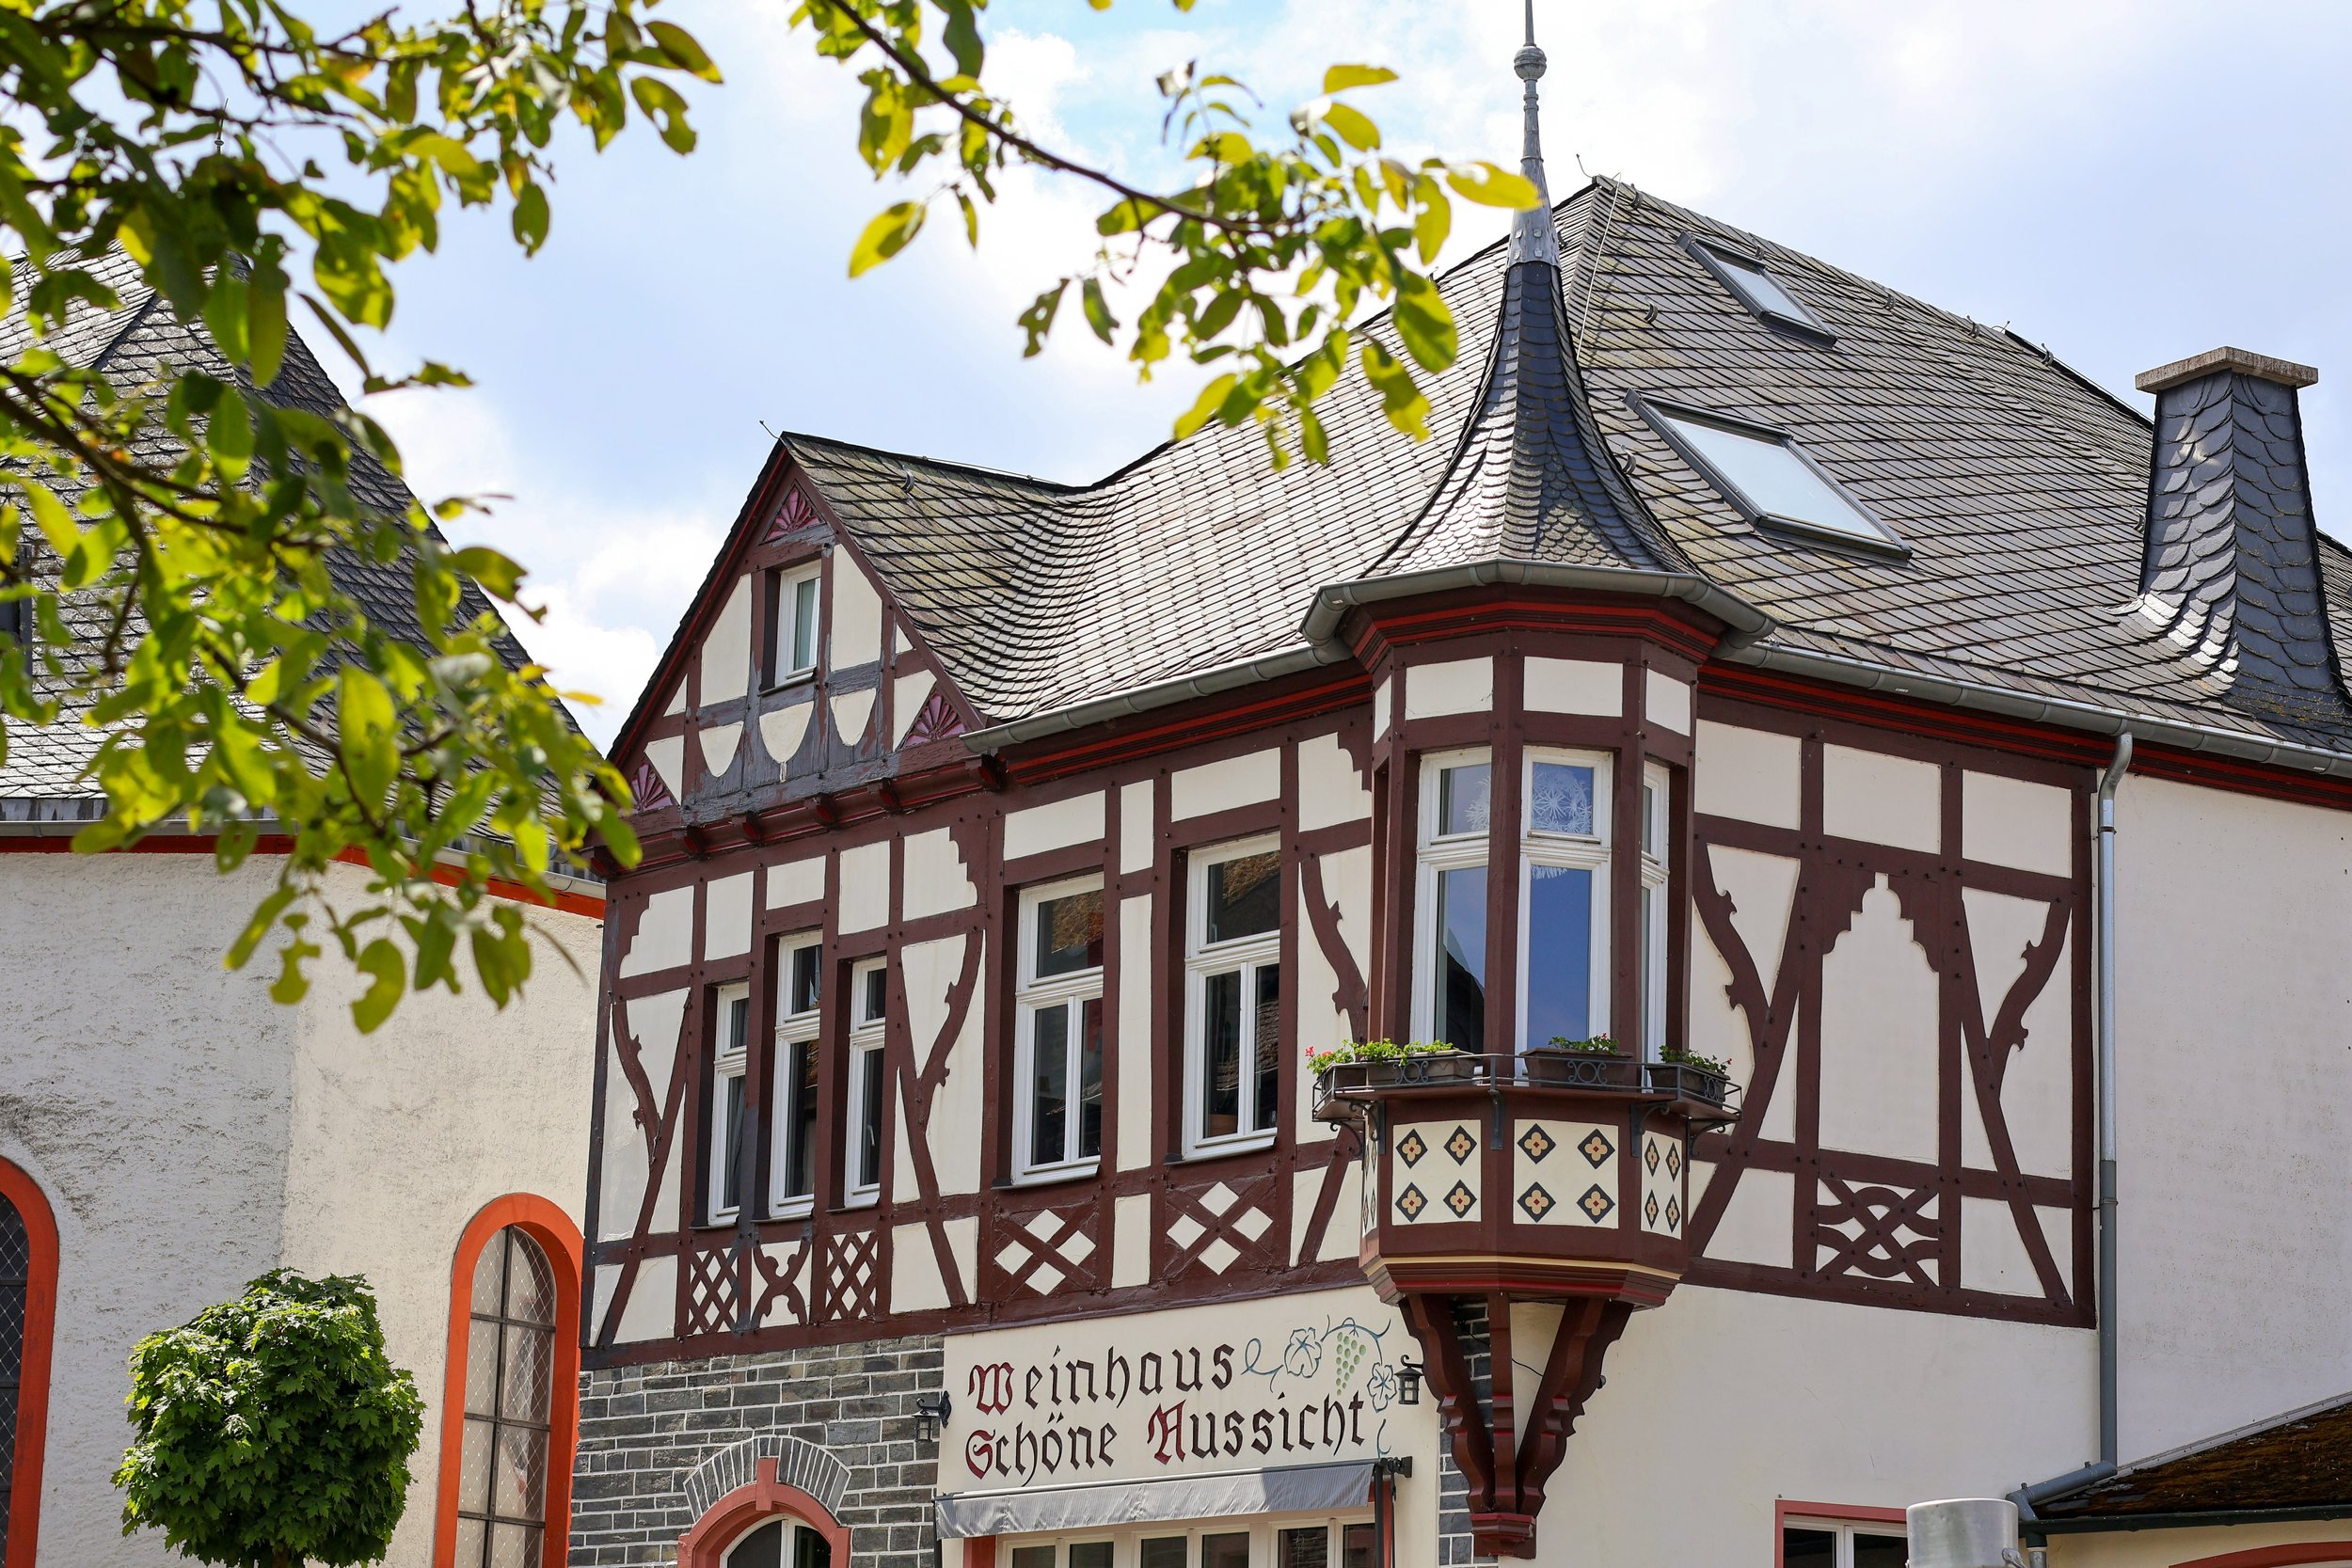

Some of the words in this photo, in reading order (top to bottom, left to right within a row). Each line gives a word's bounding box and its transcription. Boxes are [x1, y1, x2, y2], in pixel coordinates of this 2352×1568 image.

[967, 1343, 1235, 1415] Weinhaus
[965, 1412, 1118, 1487] Schöne
[1147, 1391, 1365, 1465] Aussicht
